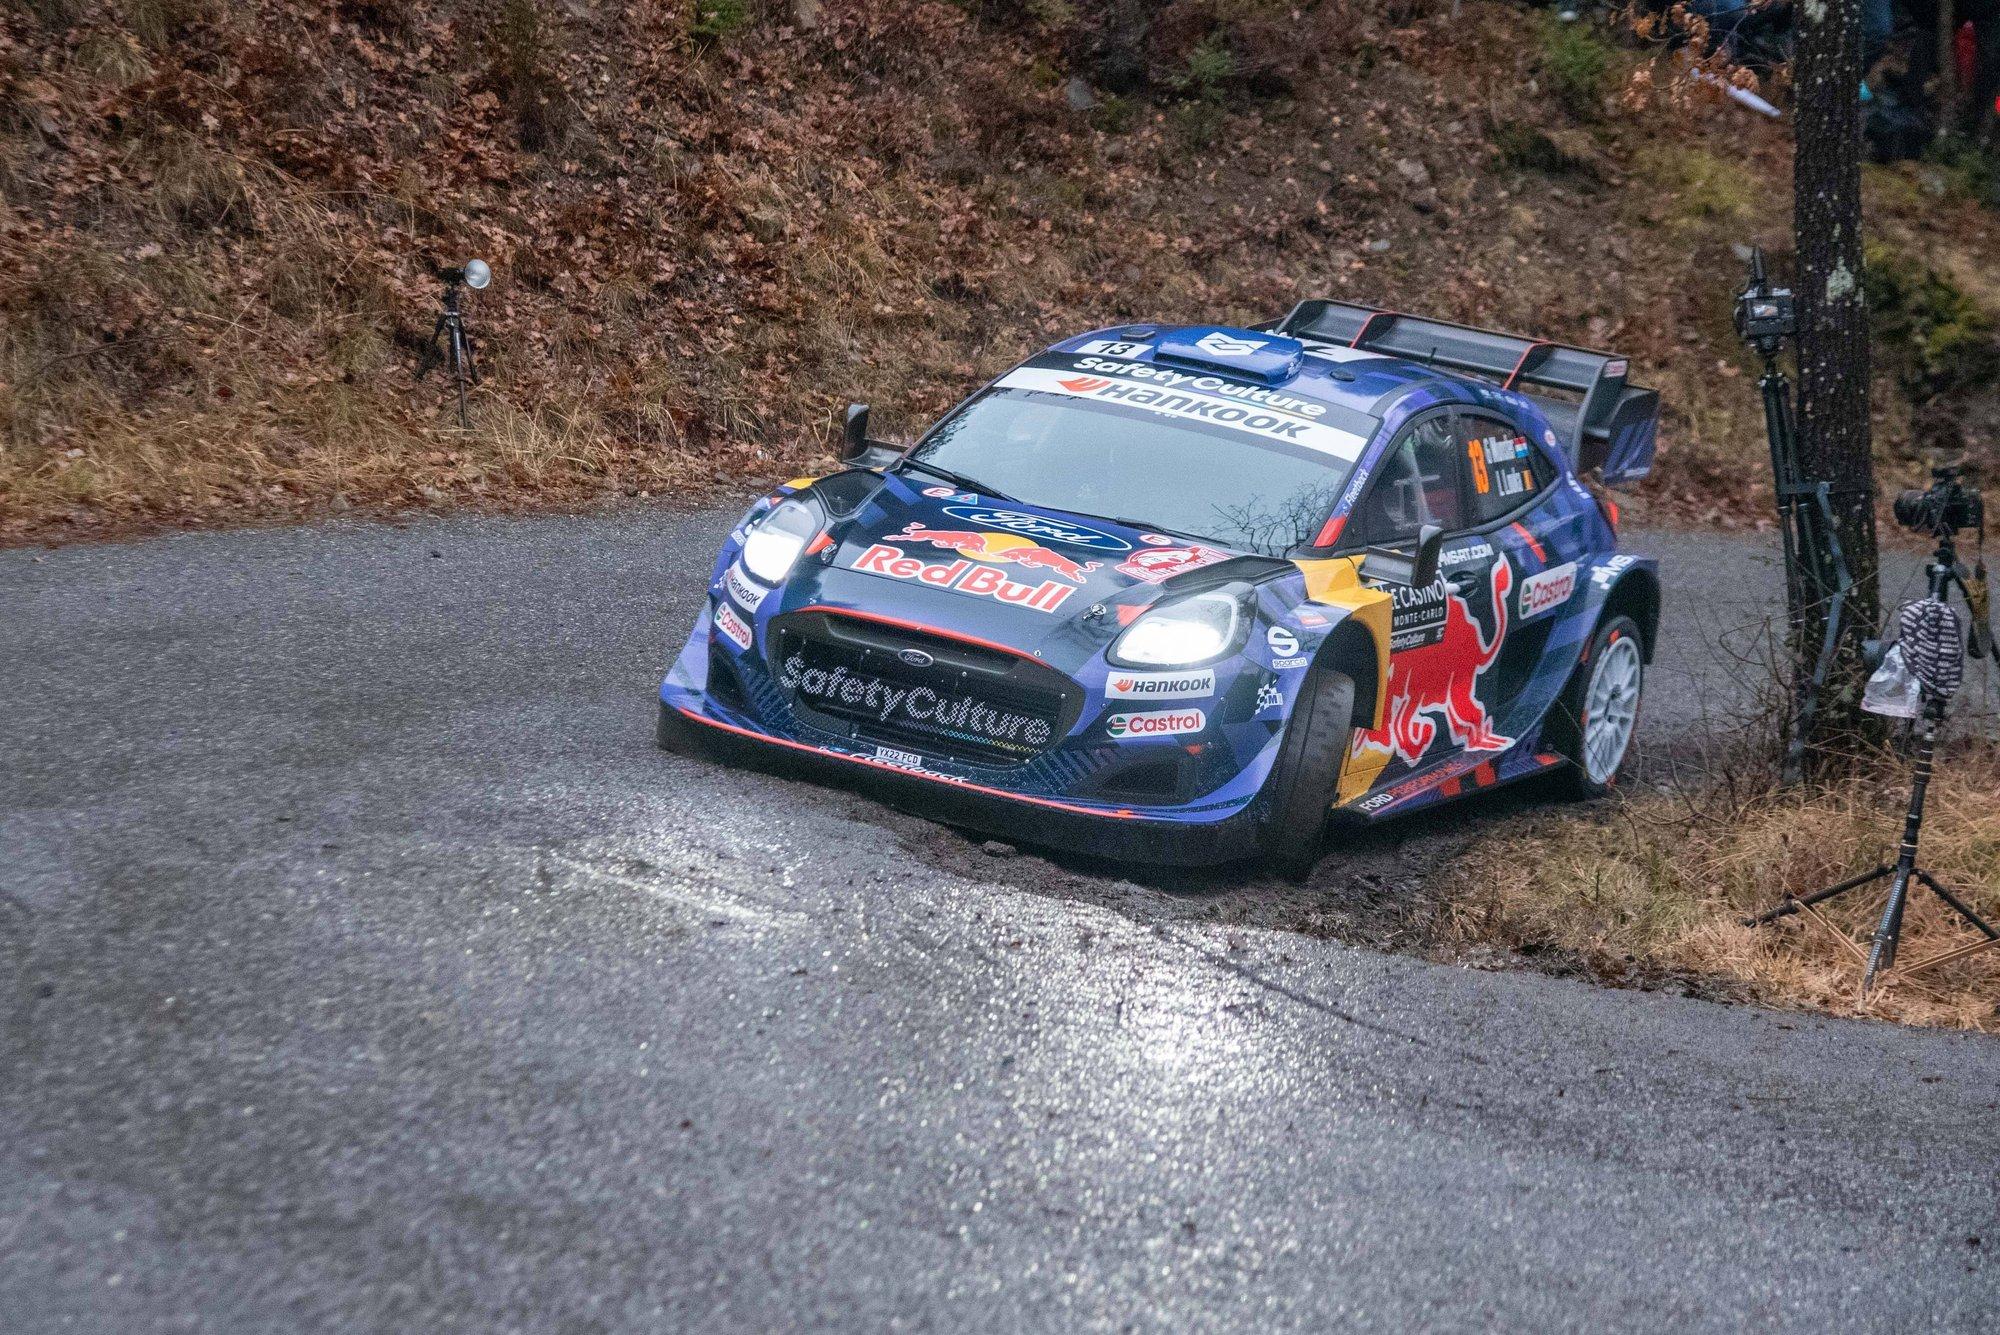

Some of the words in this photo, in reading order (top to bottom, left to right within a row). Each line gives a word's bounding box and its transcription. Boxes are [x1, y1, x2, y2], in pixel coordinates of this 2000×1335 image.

[1099, 342, 1135, 355] 13
[1073, 357, 1327, 416] SafetyCulture
[970, 511, 1103, 542] Ford
[850, 543, 971, 595] Red
[955, 562, 1079, 613] Bull
[1400, 580, 1445, 608] CASINO
[722, 612, 750, 646] Castrol
[780, 652, 1051, 745] SafetyCulture
[1128, 713, 1200, 733] Castrol
[879, 748, 900, 760] YX22
[901, 753, 919, 765] FCD
[1358, 793, 1394, 811] FORD
